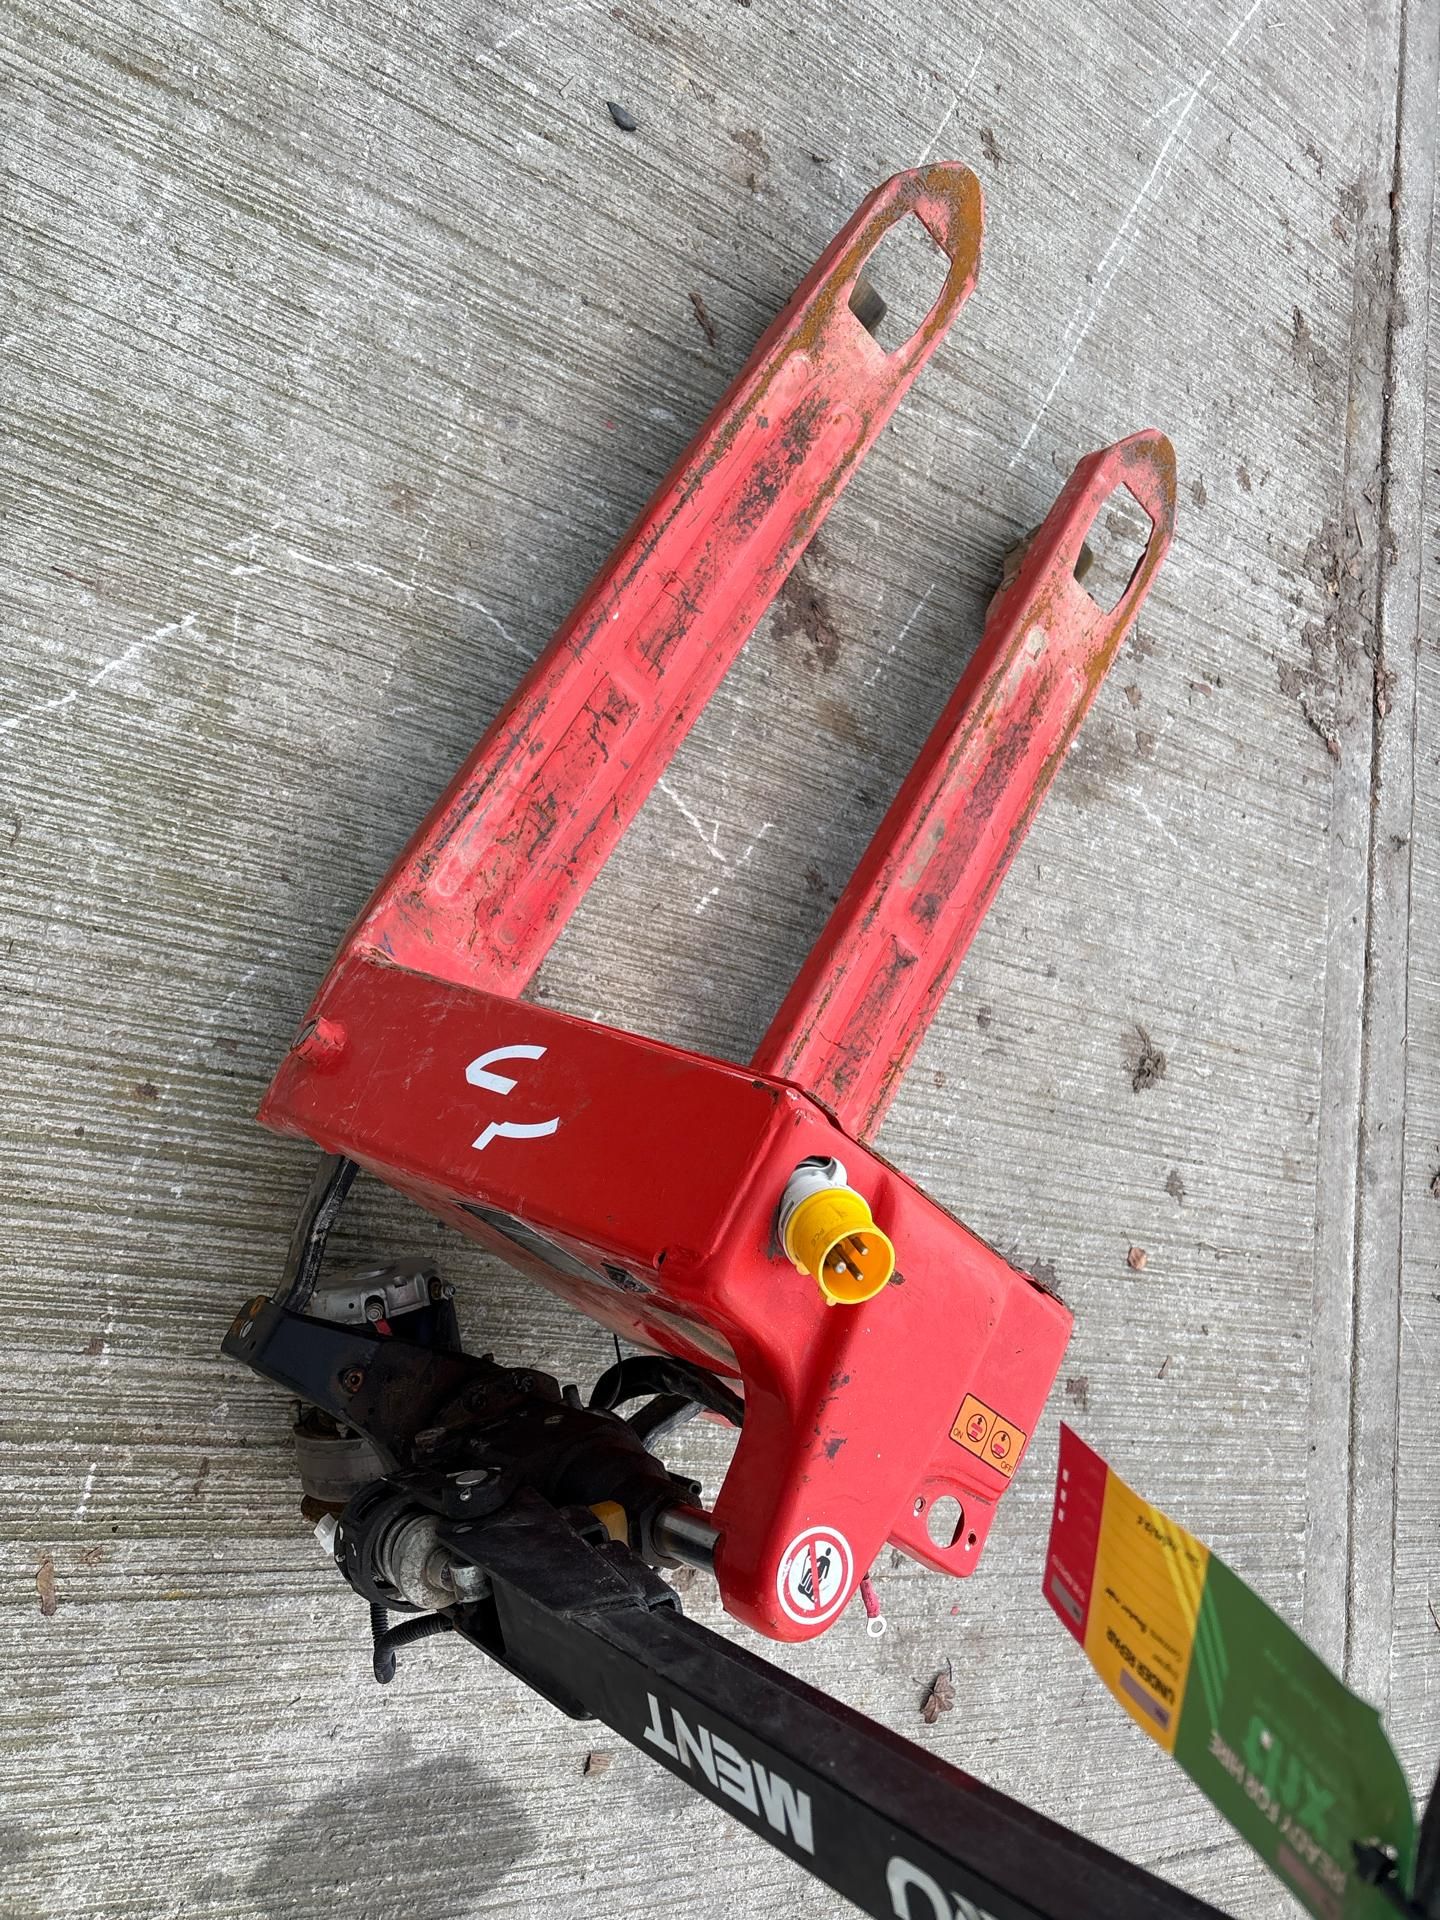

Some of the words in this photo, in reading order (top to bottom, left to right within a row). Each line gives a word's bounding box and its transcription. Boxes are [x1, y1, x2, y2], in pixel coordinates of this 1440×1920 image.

[953, 1427, 964, 1440] ON
[1001, 1461, 1013, 1472] OFF
[1106, 1625, 1137, 1668] REPAIR
[1137, 1658, 1175, 1706] UNDER
[643, 1692, 815, 1856] MENT
[1207, 1732, 1246, 1785] HIRE
[1244, 1773, 1281, 1825] FOR
[1280, 1814, 1348, 1894] READY
